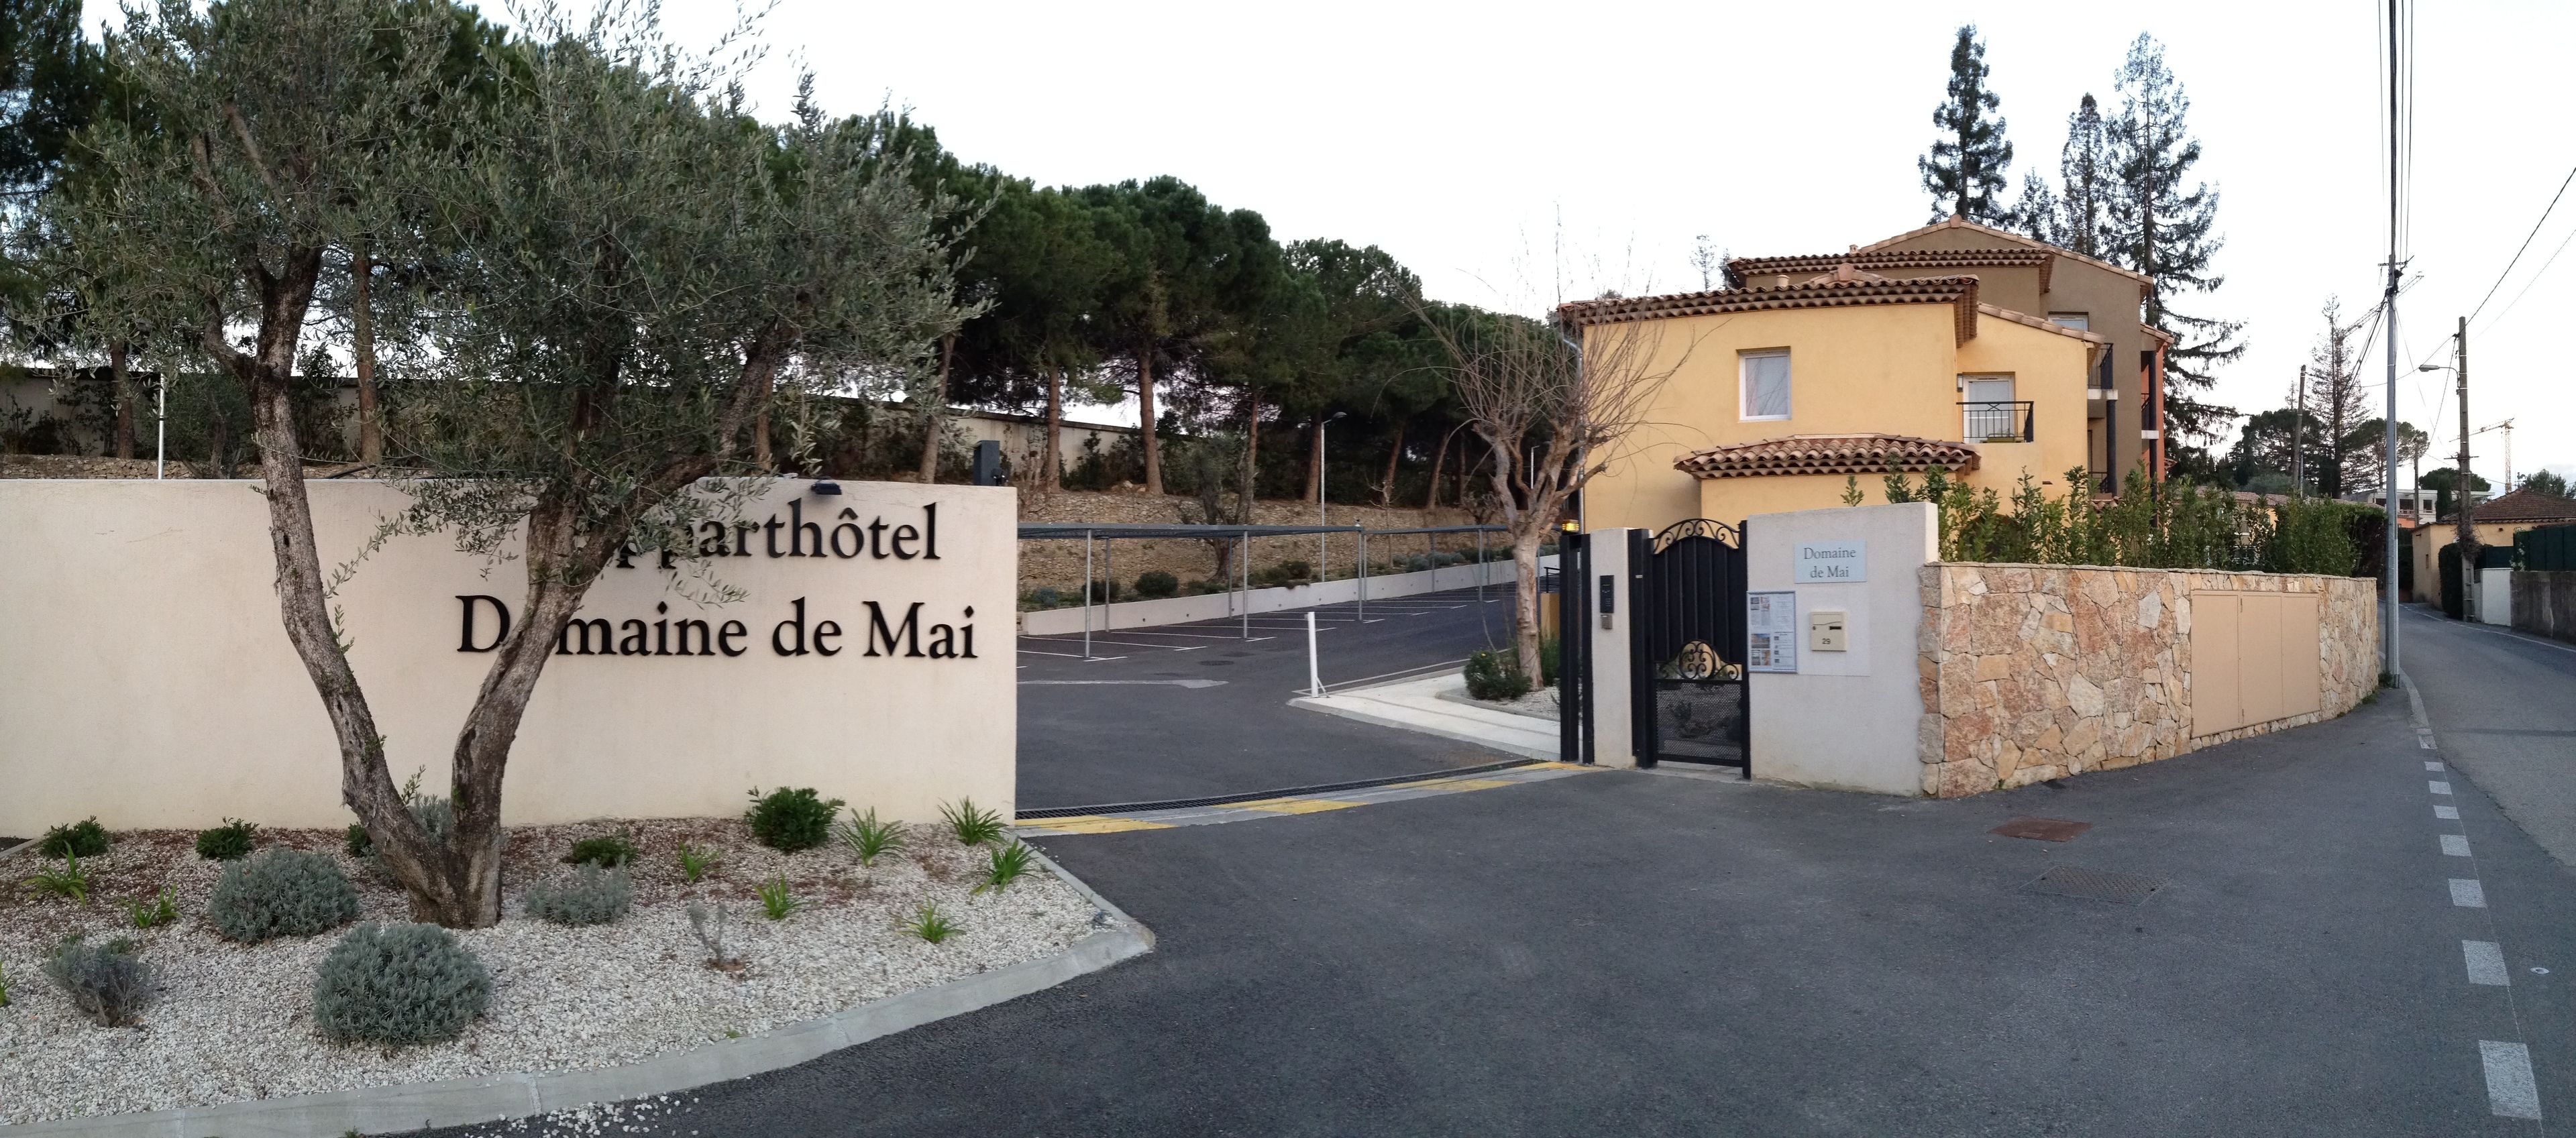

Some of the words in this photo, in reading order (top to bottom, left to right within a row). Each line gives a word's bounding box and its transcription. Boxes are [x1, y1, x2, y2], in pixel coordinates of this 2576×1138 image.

[615, 499, 941, 569] parthôtel
[1804, 547, 1856, 559] Domaine
[1810, 565, 1824, 578] de
[1827, 565, 1849, 577] Mai
[455, 595, 747, 657] Dmaine
[771, 596, 842, 657] de
[862, 601, 979, 659] Mai
